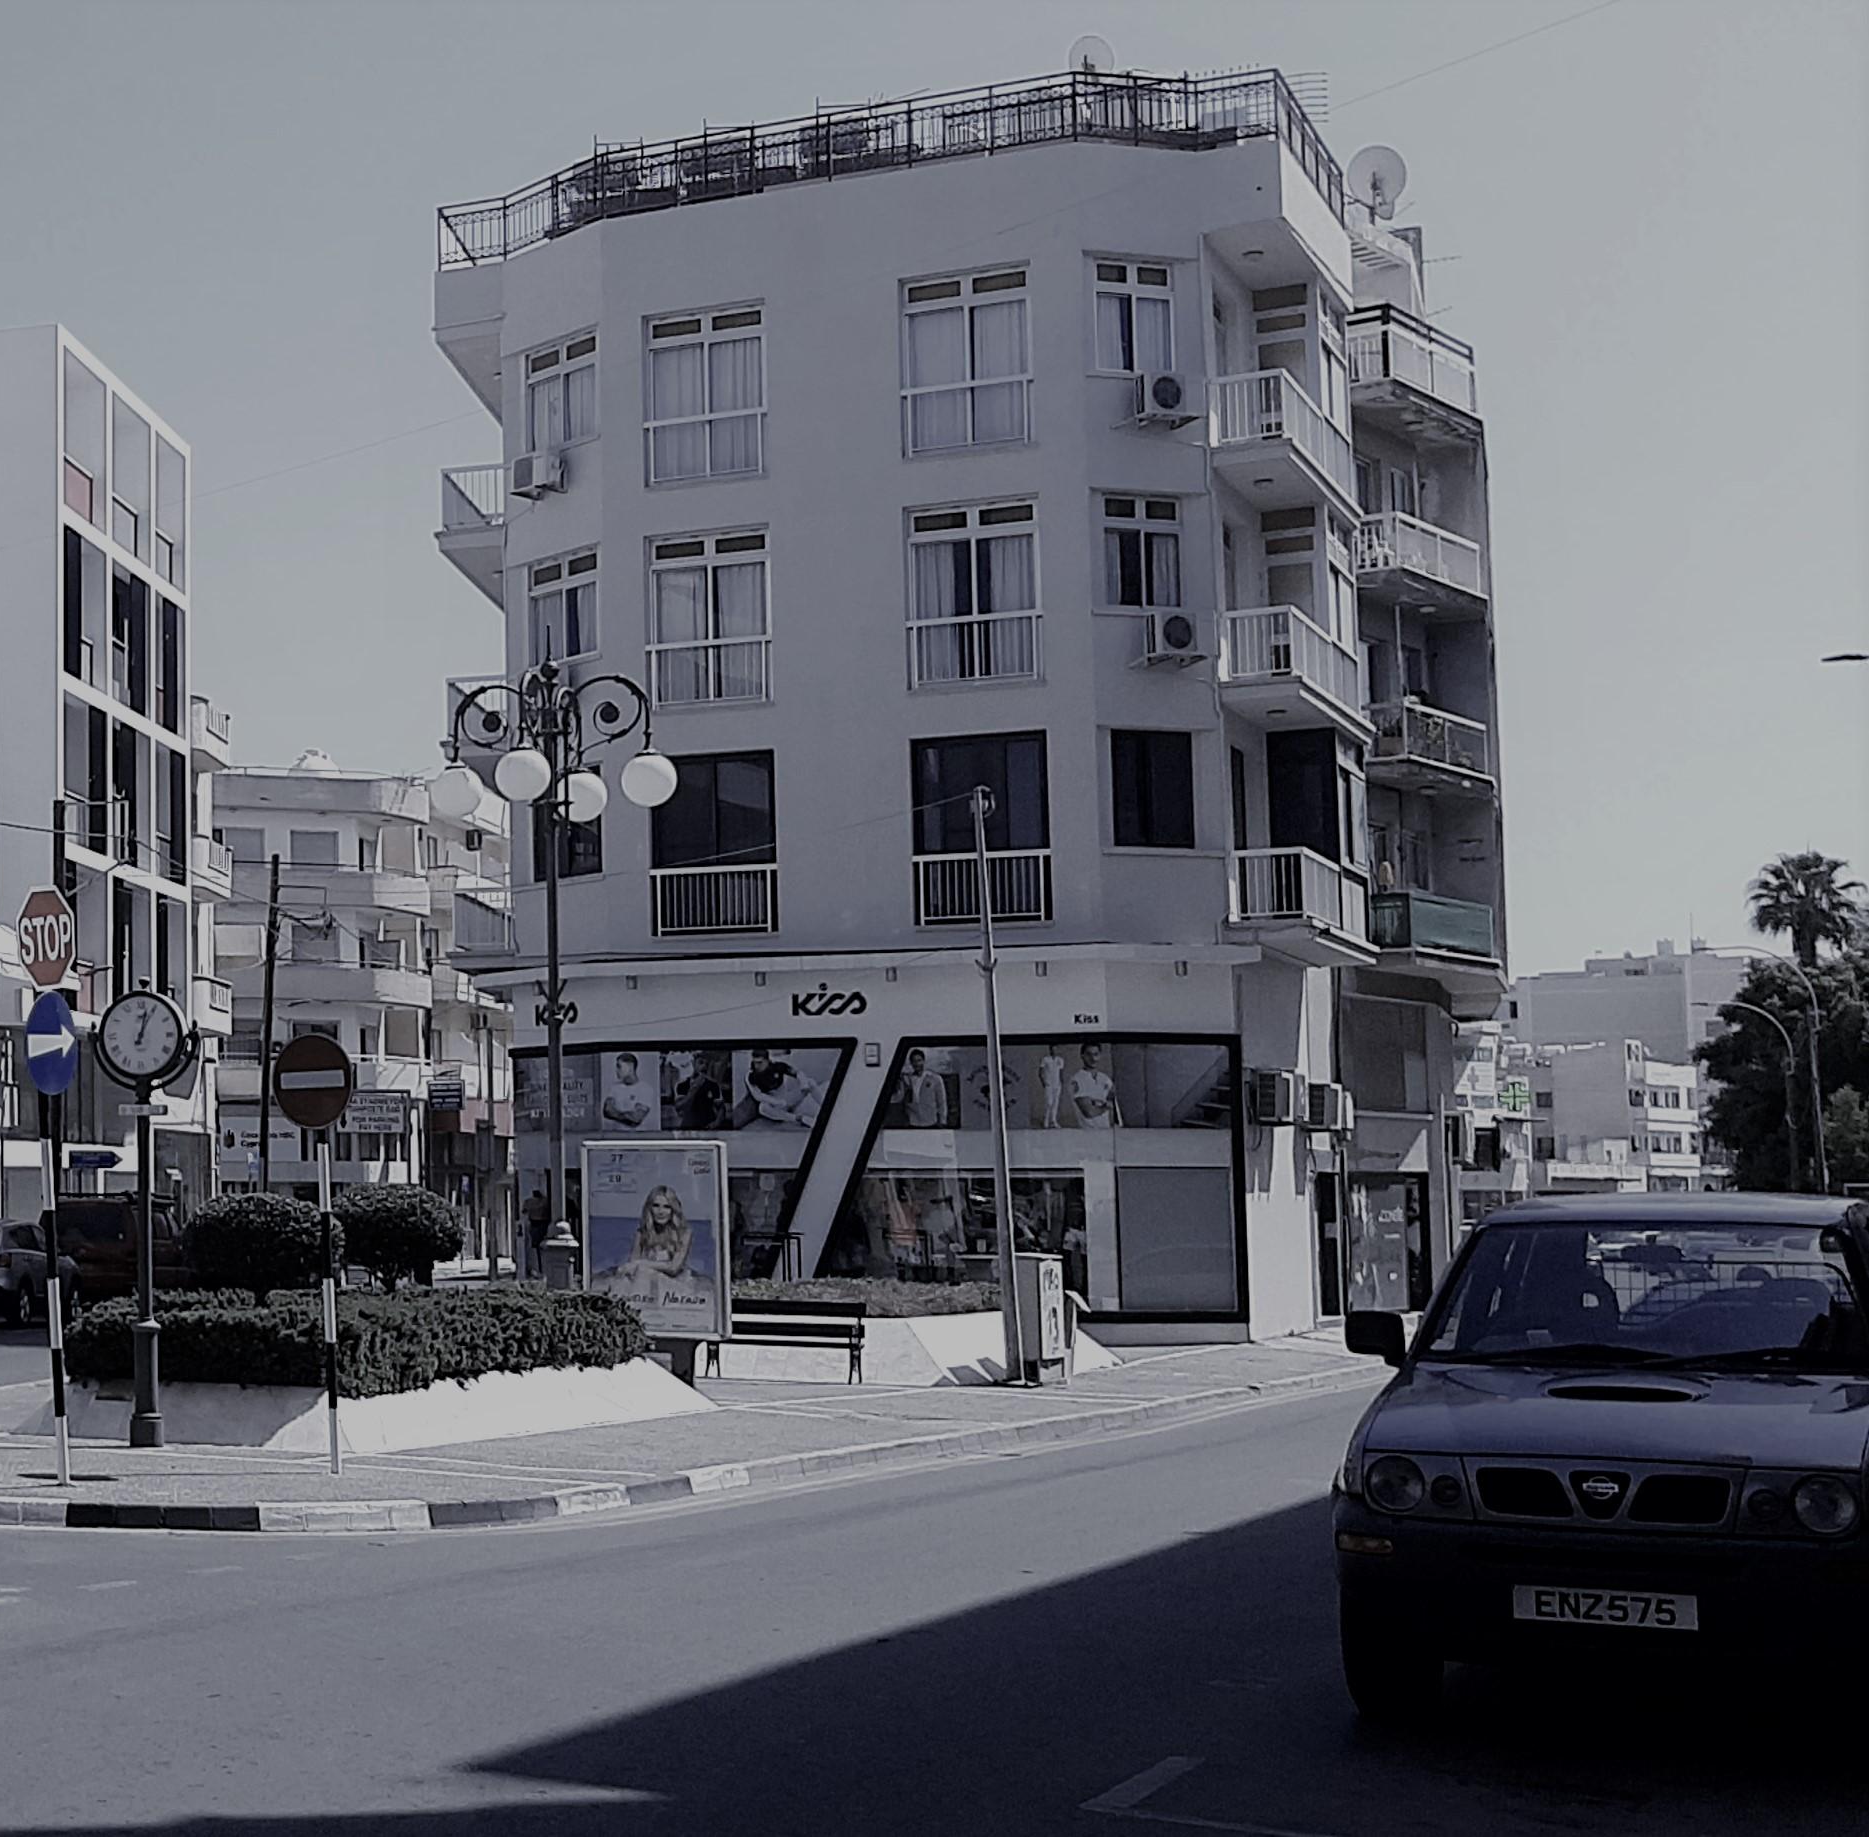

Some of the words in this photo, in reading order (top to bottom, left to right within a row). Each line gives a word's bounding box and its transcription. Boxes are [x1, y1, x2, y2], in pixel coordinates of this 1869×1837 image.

[20, 915, 70, 965] STOP
[792, 983, 867, 1016] Kiss
[1074, 1013, 1099, 1025] Kiss
[1535, 1590, 1677, 1626] ENZ575
